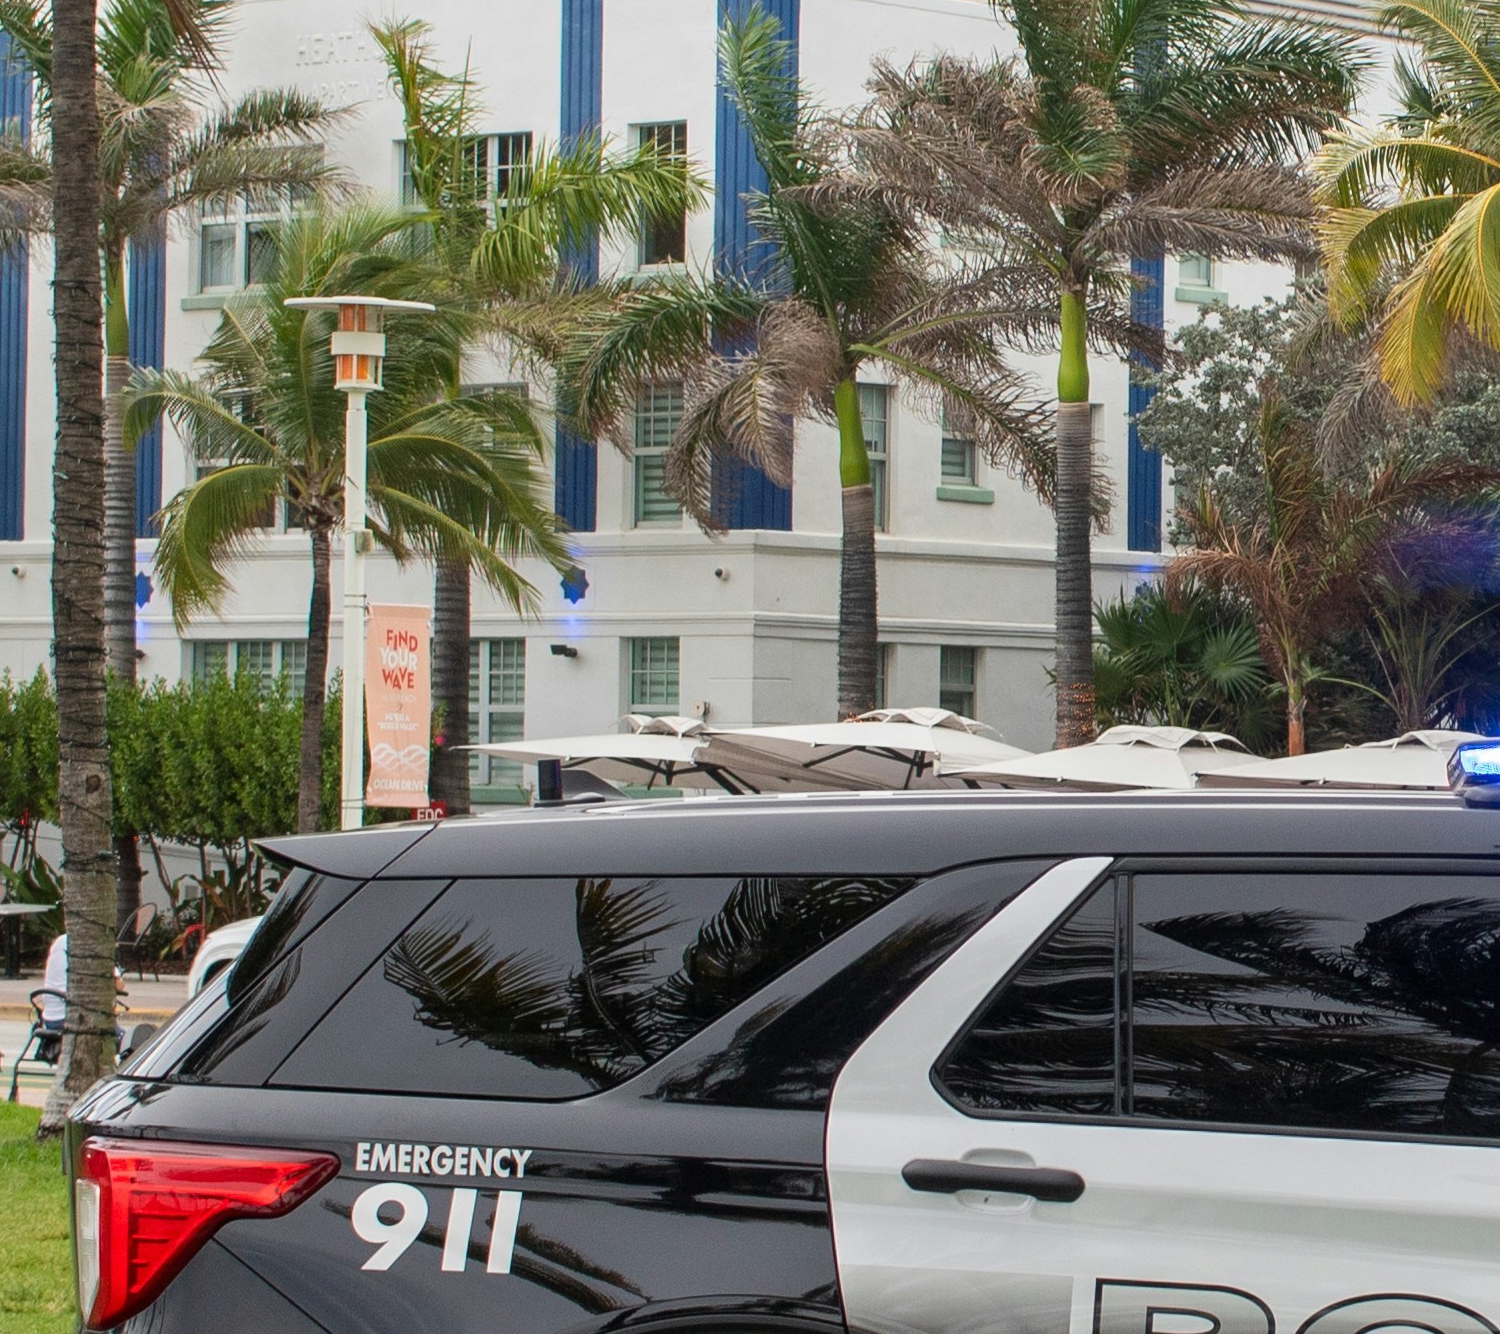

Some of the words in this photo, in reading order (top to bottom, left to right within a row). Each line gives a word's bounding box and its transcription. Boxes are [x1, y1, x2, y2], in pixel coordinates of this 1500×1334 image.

[386, 629, 418, 652] FIND
[380, 647, 418, 671] YOUR
[382, 667, 415, 689] WAVE
[373, 779, 400, 790] OCEAN
[401, 779, 424, 791] DRIVE
[355, 1142, 533, 1178] EMERGENCY
[351, 1182, 523, 1274] 911
